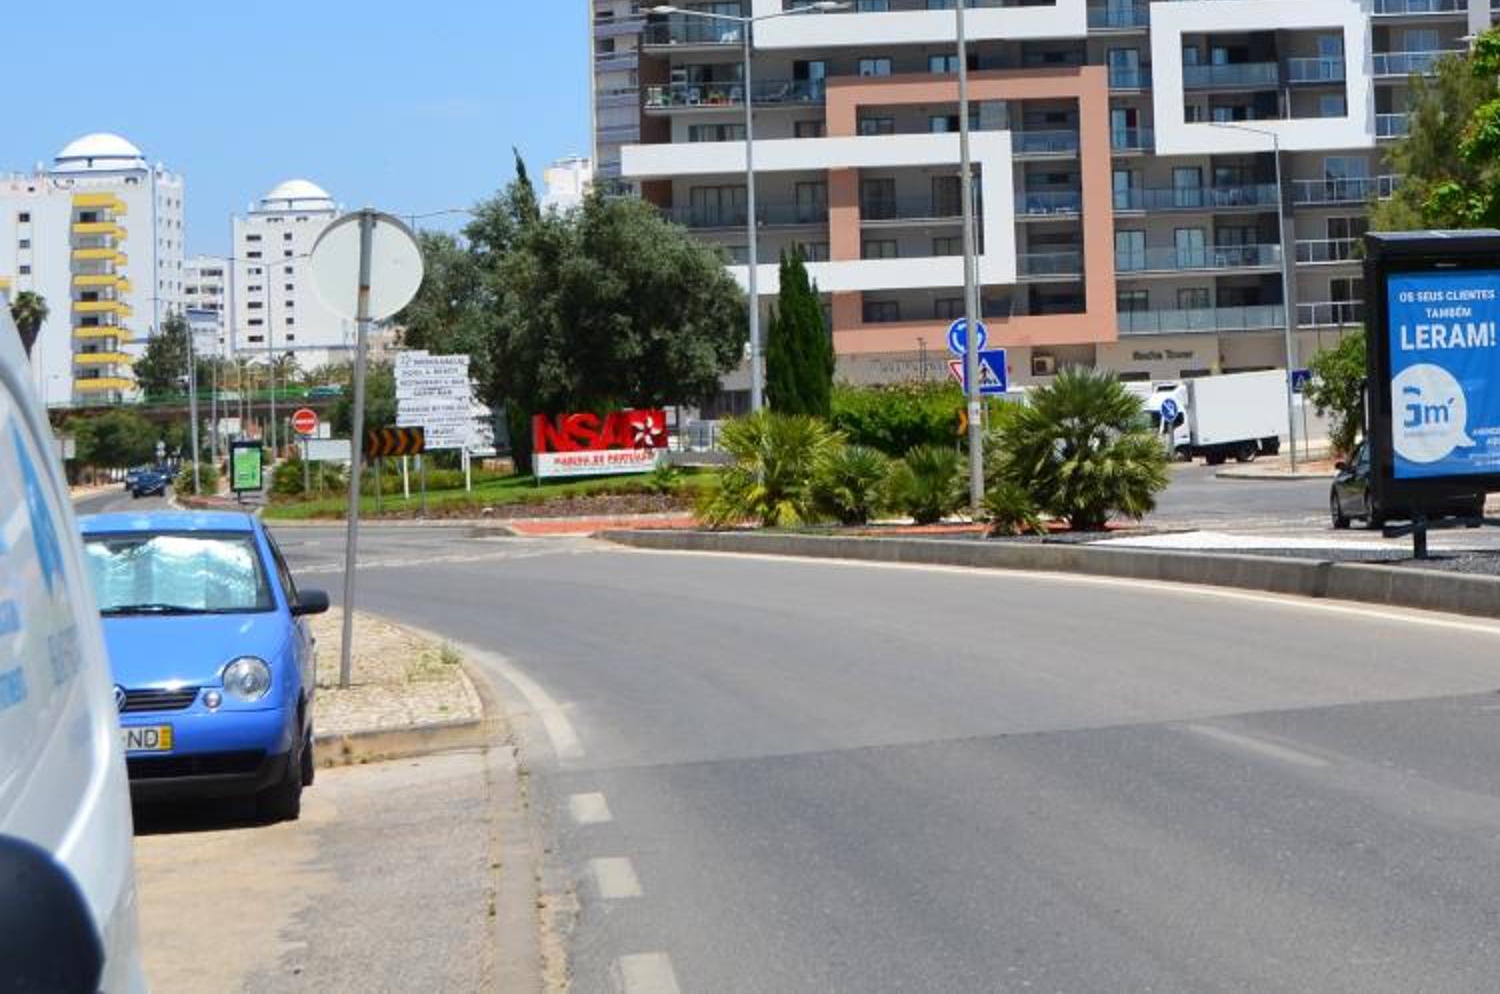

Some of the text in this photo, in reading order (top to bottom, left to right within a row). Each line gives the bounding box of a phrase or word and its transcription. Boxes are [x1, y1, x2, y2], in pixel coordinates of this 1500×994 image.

[1400, 289, 1496, 303] OS SEUS CLIENTES
[1425, 305, 1472, 319] TAMBÉM
[1400, 321, 1497, 351] LERAM!
[1164, 349, 1194, 360] Tower
